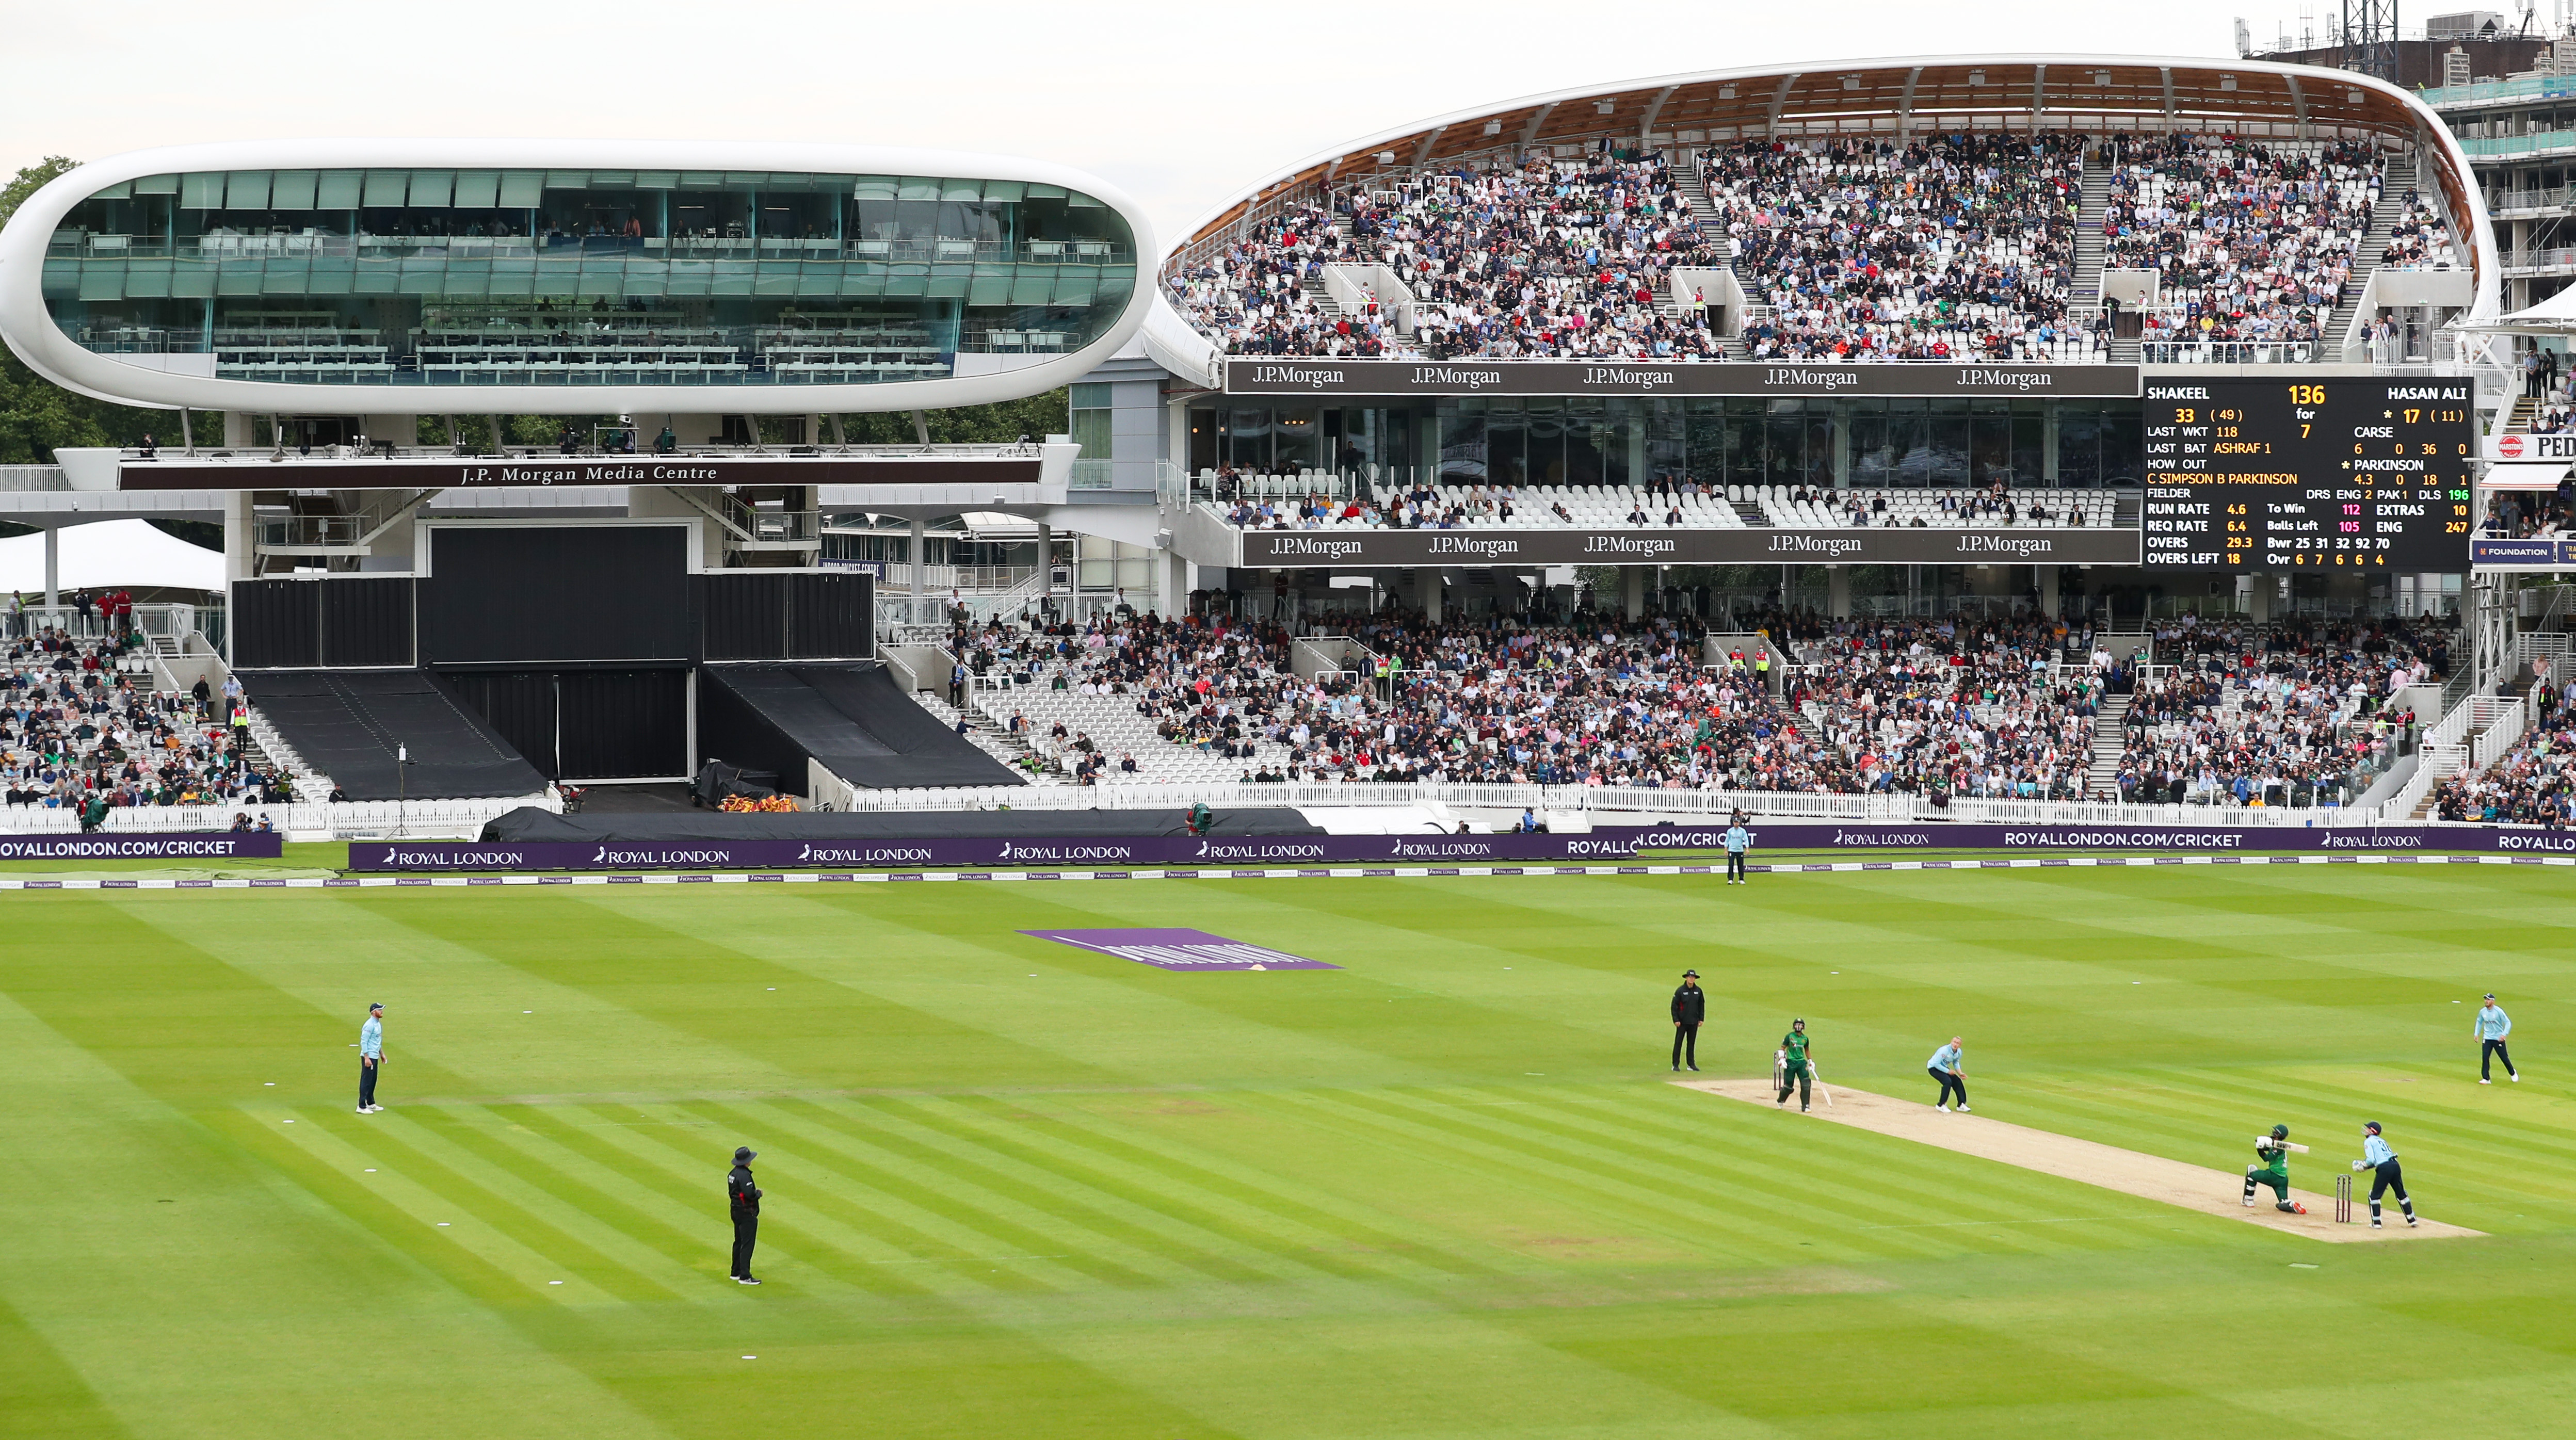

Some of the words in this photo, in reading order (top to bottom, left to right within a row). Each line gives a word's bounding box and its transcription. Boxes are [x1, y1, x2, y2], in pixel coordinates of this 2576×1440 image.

[1253, 367, 1344, 387] J.P.Morgan
[1411, 368, 1501, 389] J.P.Morgan
[1584, 368, 1673, 389] J.P.Morgan
[1765, 369, 1857, 390] J.P.Morgan
[1957, 370, 2051, 390] J.P.Morgan
[2148, 387, 2210, 399] SHAKEEL
[2289, 385, 2325, 404] 136
[2388, 387, 2438, 399] HASAN
[2442, 387, 2466, 399] ALI
[2176, 409, 2194, 423] 33
[2296, 408, 2315, 419] for
[2404, 409, 2420, 423] 17
[2148, 427, 2176, 436] LAST
[2183, 427, 2208, 436] WKT
[2217, 427, 2237, 437] 118
[2301, 425, 2310, 438] 7
[2355, 427, 2393, 438] CARSE
[2148, 444, 2176, 453] LAST
[2185, 444, 2207, 452] BAT
[2214, 443, 2260, 454] ASHRAF
[2265, 443, 2271, 454] 1
[2355, 443, 2362, 454] 6
[2395, 444, 2403, 454] 0
[2422, 444, 2436, 455] 36
[2458, 444, 2466, 454] 0
[2148, 460, 2176, 468] HOW
[2183, 459, 2207, 469] OUT
[2355, 460, 2423, 471] PARKINSON
[461, 468, 492, 485] J.P.
[502, 468, 576, 484] Morgan
[585, 466, 645, 479] Media
[653, 465, 717, 479] Centre
[2148, 473, 2155, 483] C
[2160, 473, 2213, 484] SIMPSON
[2217, 474, 2225, 483] B
[2229, 474, 2297, 484] PARKINSON
[2355, 474, 2372, 484] 4.3
[2396, 475, 2404, 484] 0
[2423, 475, 2437, 485] 18
[2461, 475, 2466, 485] 1
[2148, 489, 2191, 498] FIELDER
[2307, 490, 2330, 499] DRS
[2337, 490, 2361, 499] ENG
[2365, 490, 2372, 499] 2
[2377, 490, 2400, 499] PAK
[2403, 491, 2407, 499] 1
[2419, 490, 2441, 499] DLS
[2449, 490, 2469, 500] 196
[2148, 504, 2174, 514] RUN
[2178, 504, 2210, 514] RATE
[2227, 504, 2246, 514] 4.6
[2267, 504, 2281, 513] To
[2284, 504, 2305, 513] Win
[2343, 504, 2360, 515] 112
[2377, 505, 2424, 515] EXTRAS
[2453, 505, 2467, 515] 10
[2148, 521, 2172, 531] REQ
[2177, 521, 2208, 531] RATE
[2228, 521, 2246, 531] 6.4
[2267, 521, 2294, 530] Balls
[2297, 521, 2318, 530] Left
[2339, 522, 2359, 532] 105
[2377, 522, 2402, 532] ENG
[2446, 522, 2467, 532] 247
[1429, 538, 1518, 557] J.P.Morgan
[1585, 537, 1675, 557] J.P.Morgan
[1769, 536, 1862, 556] J.P.Morgan
[1957, 536, 2052, 556] J.P.Morgan
[2148, 537, 2188, 547] OVERS
[2227, 537, 2252, 547] 29.3
[2267, 537, 2292, 548] Bwr
[2296, 538, 2310, 548] 25
[2316, 538, 2327, 548] 31
[2336, 538, 2349, 548] 32
[2356, 538, 2370, 548] 92
[2376, 538, 2390, 548] 70
[1270, 538, 1362, 559] J.P.Morgan
[2148, 553, 2187, 563] OVERS
[2192, 553, 2219, 563] LEFT
[2227, 554, 2240, 564] 18
[2267, 554, 2290, 564] Ovr
[2296, 554, 2304, 564] 6
[2315, 554, 2323, 564] 7
[2336, 555, 2343, 565] 6
[2356, 555, 2363, 565] 6
[2376, 555, 2384, 565] 4
[1636, 832, 1757, 846] N.COM/CRICT
[1845, 834, 1878, 844] ROYAL
[1881, 834, 1929, 845] LONDON
[2006, 833, 2242, 847] ROYALLONDON.COM/CRICKET
[2333, 836, 2369, 847] ROYAL
[2372, 836, 2421, 847] LONDON
[2499, 836, 2575, 850] ROYALLO
[1, 841, 235, 856] OYALLONDON.COM/CRICKET
[1014, 848, 1061, 859] ROYAL
[1066, 847, 1130, 858] LONDON
[1211, 846, 1257, 857] ROYAL
[1261, 845, 1323, 856] LONDON
[1403, 845, 1439, 855] ROYAL
[1442, 844, 1490, 854] LONDON
[399, 853, 449, 864] ROYAL
[454, 853, 522, 864] LONDON
[609, 852, 657, 863] ROYAL
[662, 851, 729, 862] LONDON
[814, 850, 861, 861] ROYAL
[866, 849, 931, 860] LONDON
